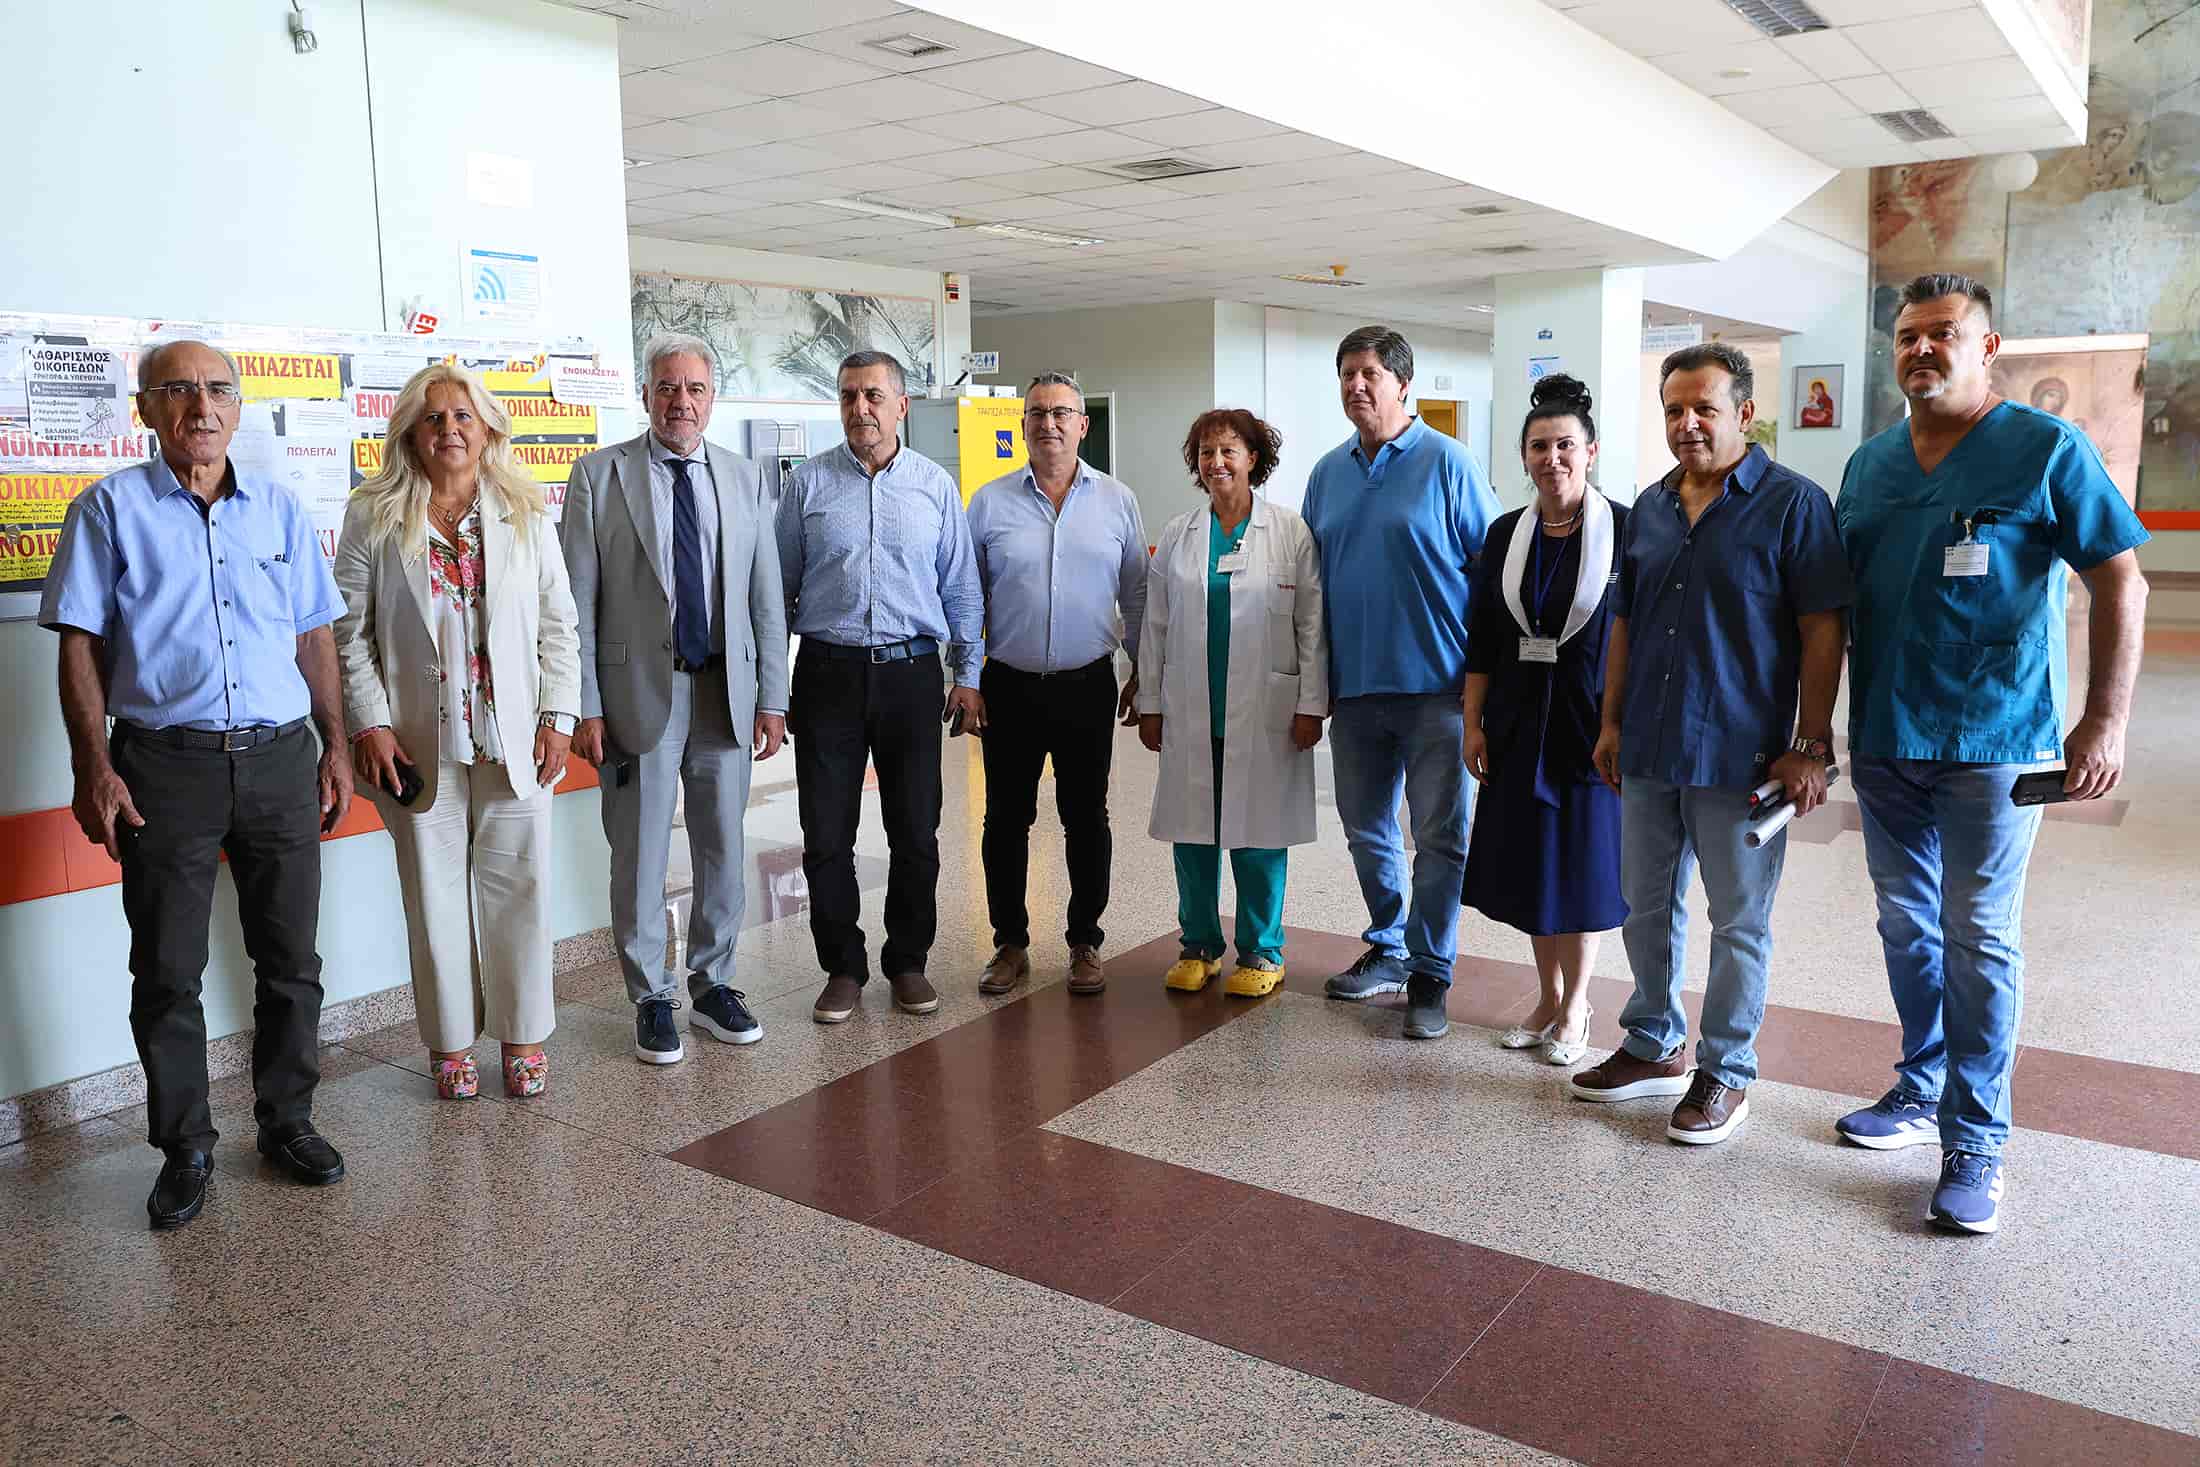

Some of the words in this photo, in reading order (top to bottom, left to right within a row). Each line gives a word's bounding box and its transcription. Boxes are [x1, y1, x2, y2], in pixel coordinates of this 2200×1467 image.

[33, 361, 104, 373] ΟΙΚΟΠΕΔΩΝ
[562, 366, 619, 377] ΕΝΟΙΚΙΑΖΕΤΑΙ
[502, 399, 592, 417] ΟΙΚΙΑΖΕΤΑΙ
[287, 447, 337, 457] ΠΩΛΕΙΤΑΙ
